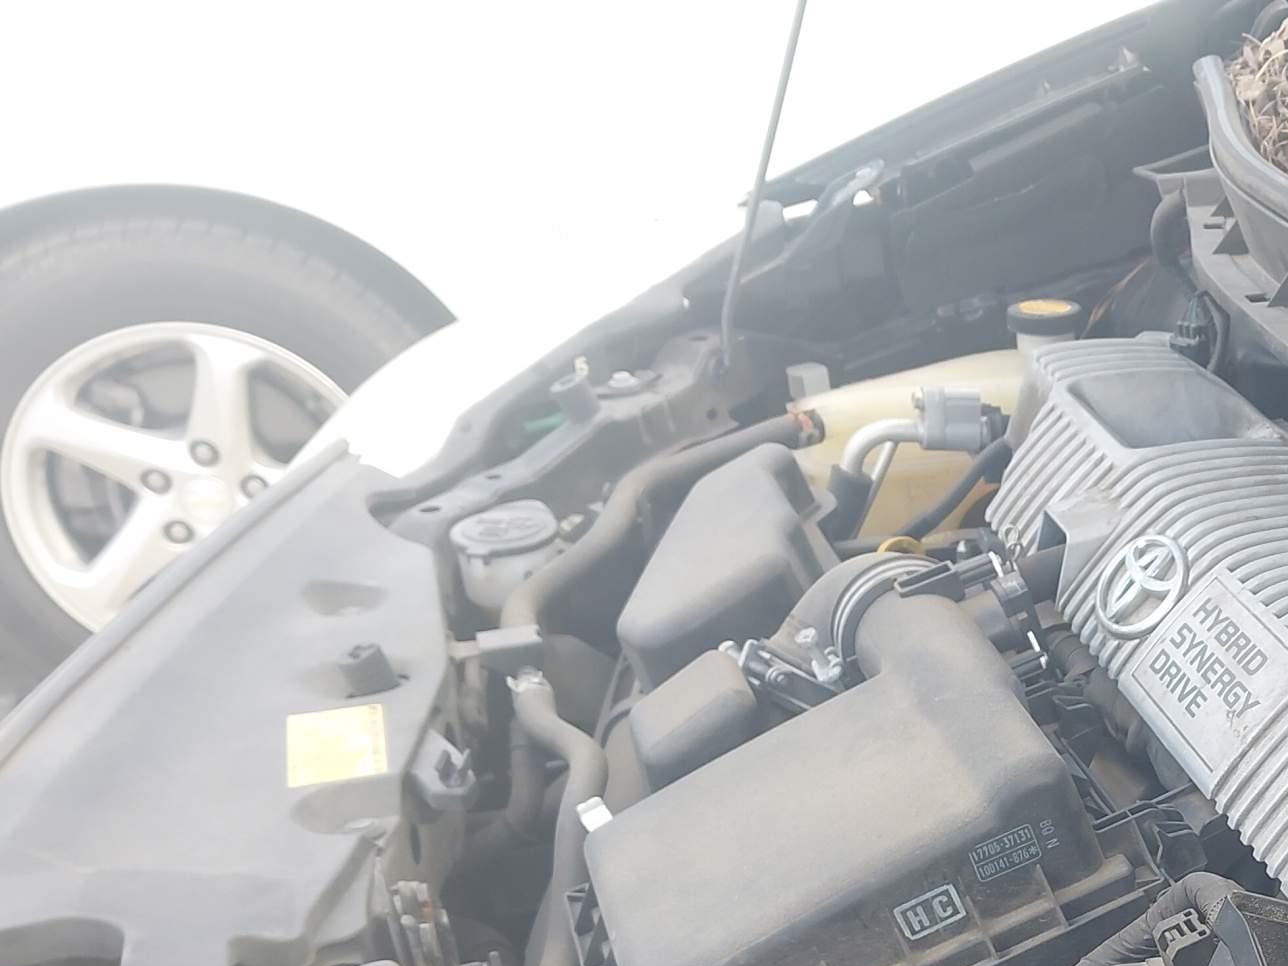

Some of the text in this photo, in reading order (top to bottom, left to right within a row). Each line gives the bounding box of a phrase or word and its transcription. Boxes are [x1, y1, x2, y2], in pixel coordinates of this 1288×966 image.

[1169, 623, 1261, 718] SYNERGY
[1192, 597, 1268, 676] HYBRID
[1150, 648, 1208, 718] DRIVE
